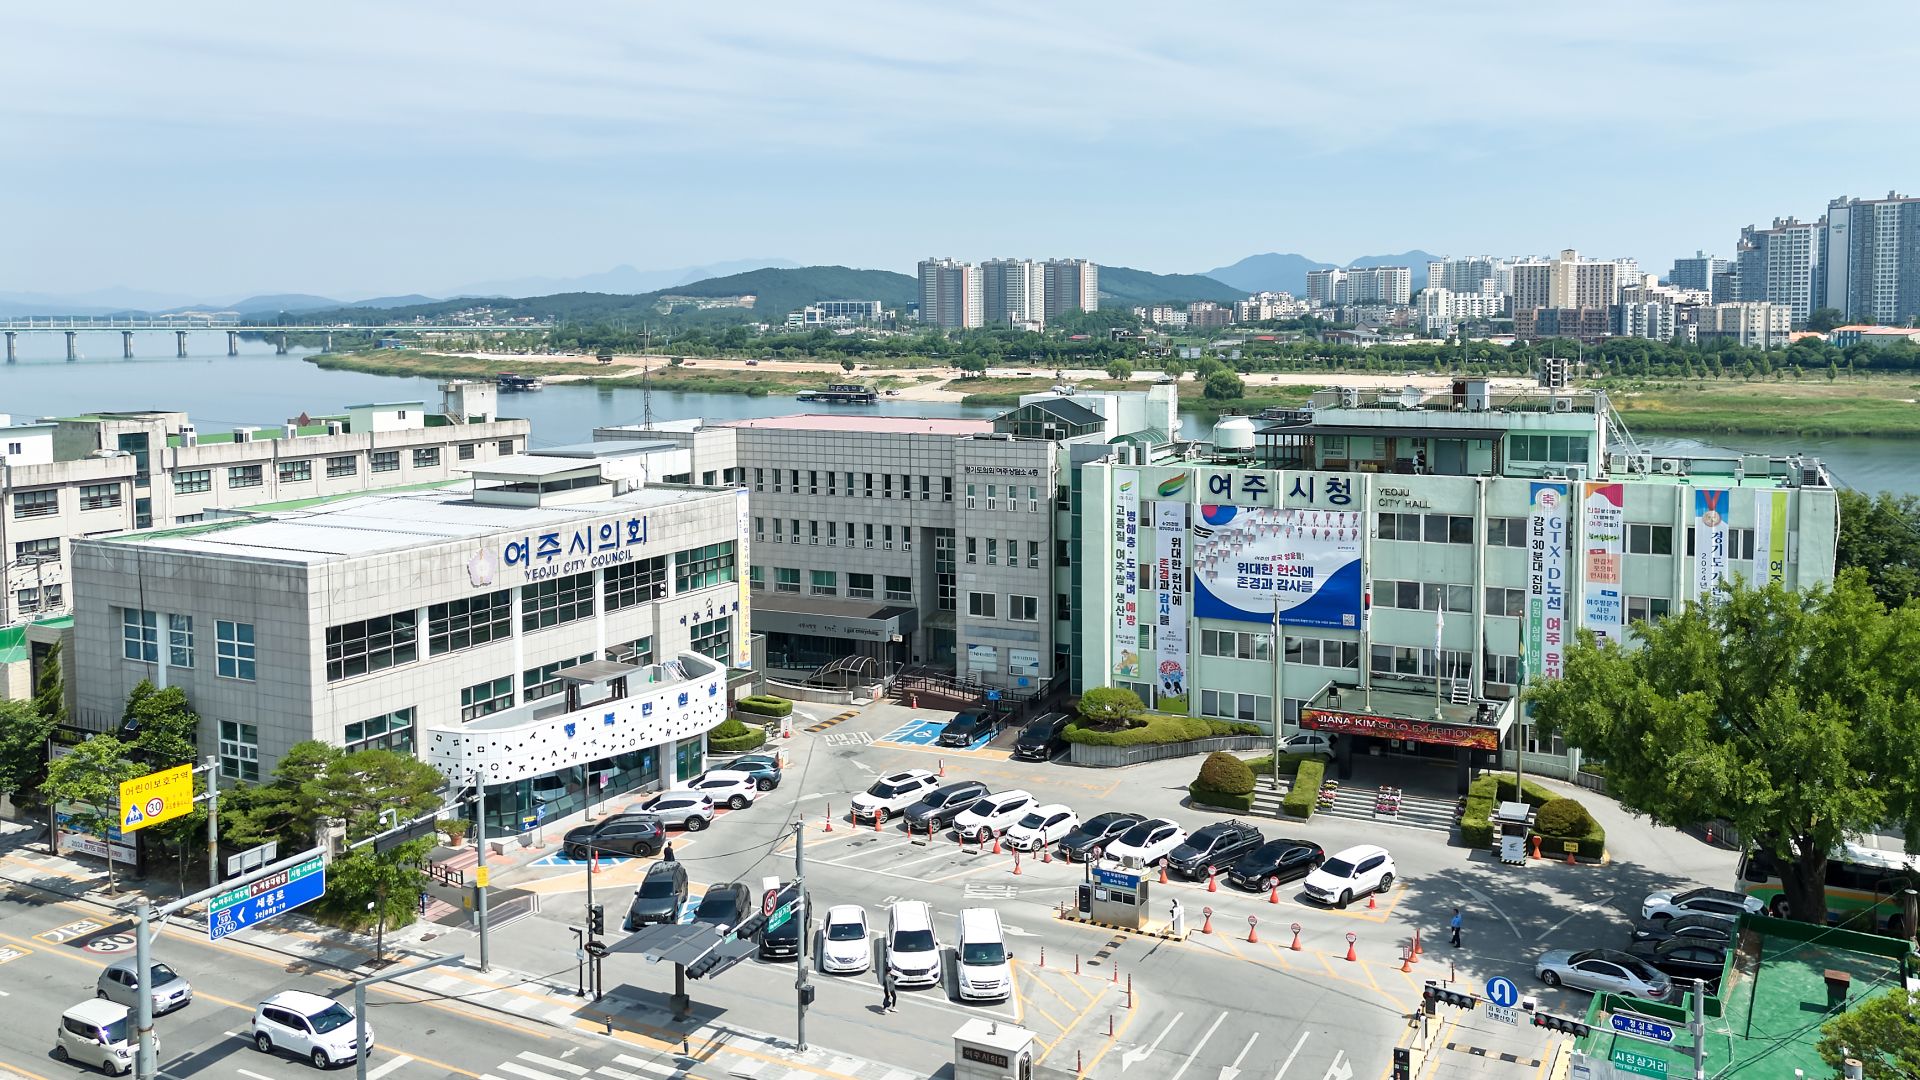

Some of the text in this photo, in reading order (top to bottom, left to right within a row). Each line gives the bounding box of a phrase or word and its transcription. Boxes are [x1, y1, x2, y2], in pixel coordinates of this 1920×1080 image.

[965, 466, 995, 474] 경기도의회
[996, 467, 1027, 476] 여주상담소
[1208, 473, 1353, 505] 여주시청
[1378, 487, 1410, 498] YEOJU
[1378, 498, 1432, 509] CITY HALL
[1532, 516, 1544, 538] 강남
[504, 515, 648, 567] 여주시의회
[525, 549, 634, 582] YEOJU CITY COUNCIL
[1115, 505, 1126, 629] 고품질 여주쌀 생산!
[1171, 537, 1182, 607] 위대한 헌신에
[1237, 562, 1314, 580] 위대한 헌신에
[1700, 552, 1709, 589] 2024년
[1159, 557, 1170, 626] 존경과 감사를
[1237, 576, 1314, 594] 존경과 감사를
[1531, 574, 1543, 596] 진입
[1125, 602, 1137, 627] 예방
[1545, 617, 1561, 646] 여주
[1317, 716, 1351, 725] JIANA
[1354, 719, 1376, 728] KIM
[1377, 721, 1409, 731] SOLO
[1411, 724, 1472, 739] EXHIBITION
[125, 771, 189, 796] 어린이보호구역
[148, 800, 162, 813] 30
[256, 890, 286, 908] 세종로
[254, 902, 286, 921] Sejong-ro
[88, 934, 135, 952] 30
[1614, 1019, 1671, 1038] 151 청심로 155
[965, 1050, 1007, 1068] 여주시의회
[1615, 1051, 1667, 1073] 시청삼거리
